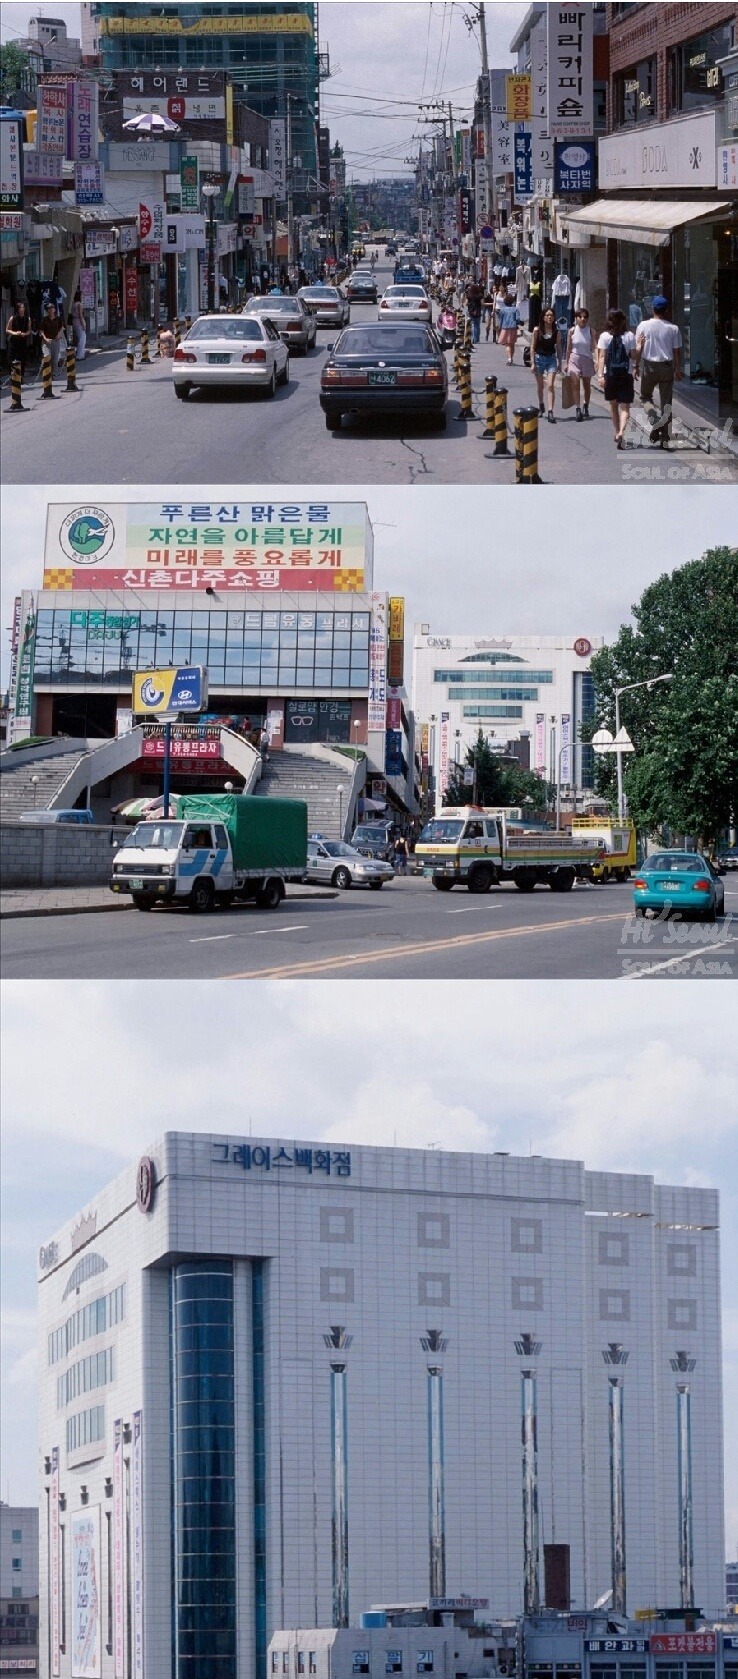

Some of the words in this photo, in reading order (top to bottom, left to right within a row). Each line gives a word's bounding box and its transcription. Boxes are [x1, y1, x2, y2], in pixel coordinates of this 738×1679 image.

[555, 11, 586, 118] 빠리커피숍
[130, 76, 211, 93] 헤어랜드
[76, 83, 92, 160] 노래연습장
[159, 504, 241, 523] 푸른산
[251, 504, 331, 523] 맑은물
[148, 526, 226, 546] 자연을
[234, 526, 343, 546] 아름답게
[146, 549, 226, 567] 미래를
[234, 549, 341, 567] 풍요롭게
[122, 569, 281, 589] 신촌다주쇼핑
[211, 1143, 351, 1177] 그레이스백화점
